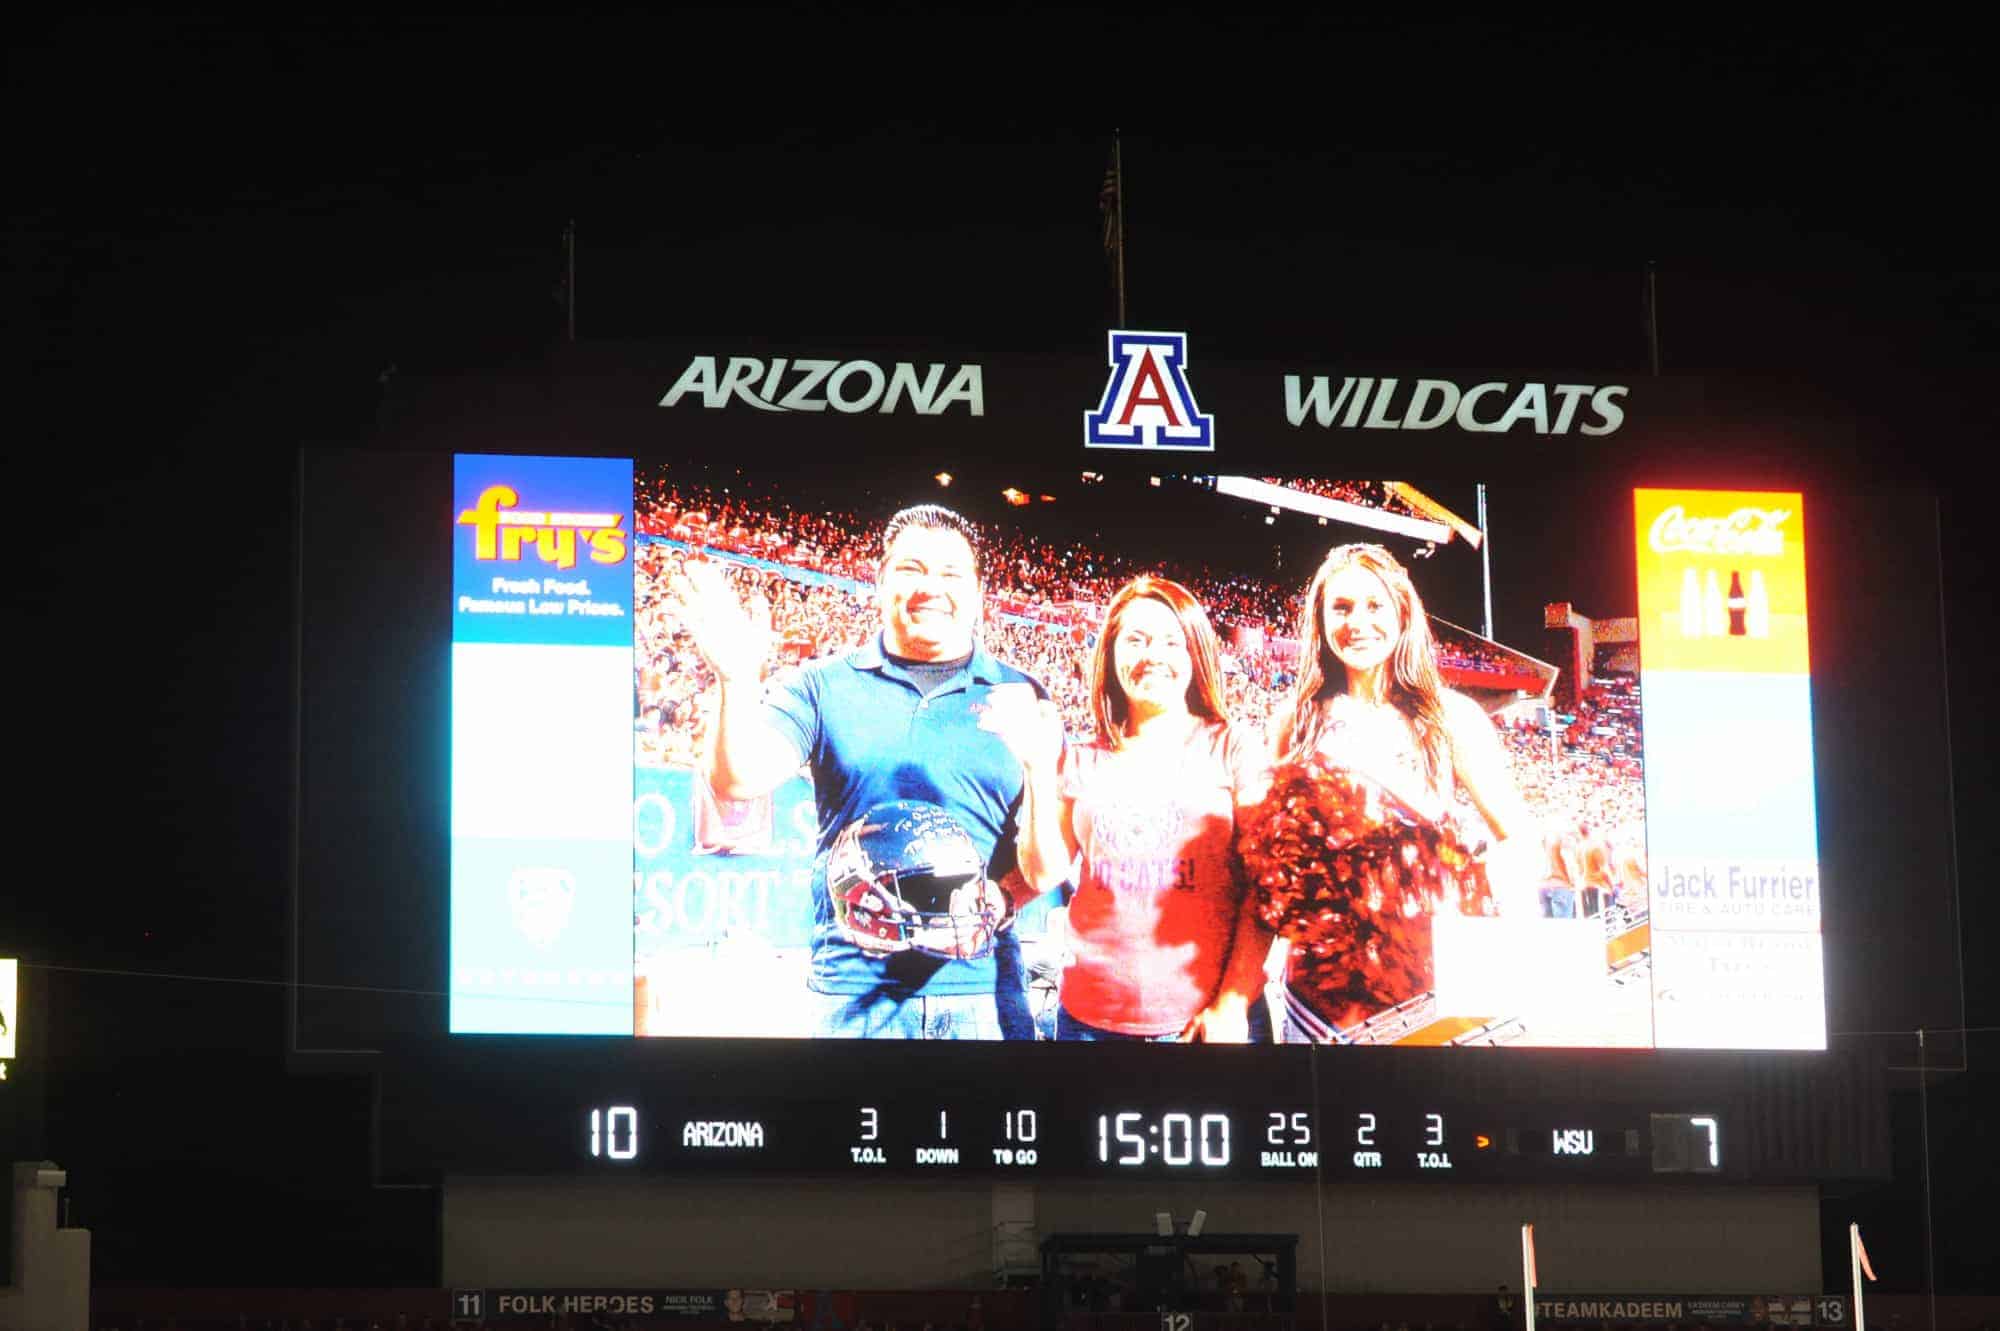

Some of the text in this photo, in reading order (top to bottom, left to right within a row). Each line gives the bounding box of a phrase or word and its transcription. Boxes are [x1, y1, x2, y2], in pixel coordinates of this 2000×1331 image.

[659, 356, 984, 416] ARIZONA
[1084, 330, 1214, 451] A
[1284, 375, 1629, 436] WILDCATS
[528, 599, 565, 614] Low
[1656, 865, 1815, 900] Jack Furrier
[590, 1105, 638, 1160] 10
[683, 1121, 764, 1148] ARIZONA
[860, 1107, 878, 1140] 3
[940, 1110, 947, 1139] 1
[1005, 1109, 1037, 1142] 10
[1267, 1112, 1311, 1145] 25
[1357, 1113, 1376, 1145] 2
[1425, 1113, 1443, 1145] 3
[1098, 1112, 1231, 1167] 15:00
[1552, 1129, 1594, 1155] WSU
[1689, 1117, 1720, 1167] 7
[915, 1148, 959, 1164] DOWN
[992, 1149, 1038, 1165] TO GO
[1260, 1151, 1318, 1167] BALL ON
[1353, 1151, 1382, 1168] QTR
[458, 1294, 480, 1316] 11
[499, 1295, 654, 1314] FOLK HEROES
[1816, 1301, 1843, 1322] 13
[1164, 1313, 1190, 1331] 12
